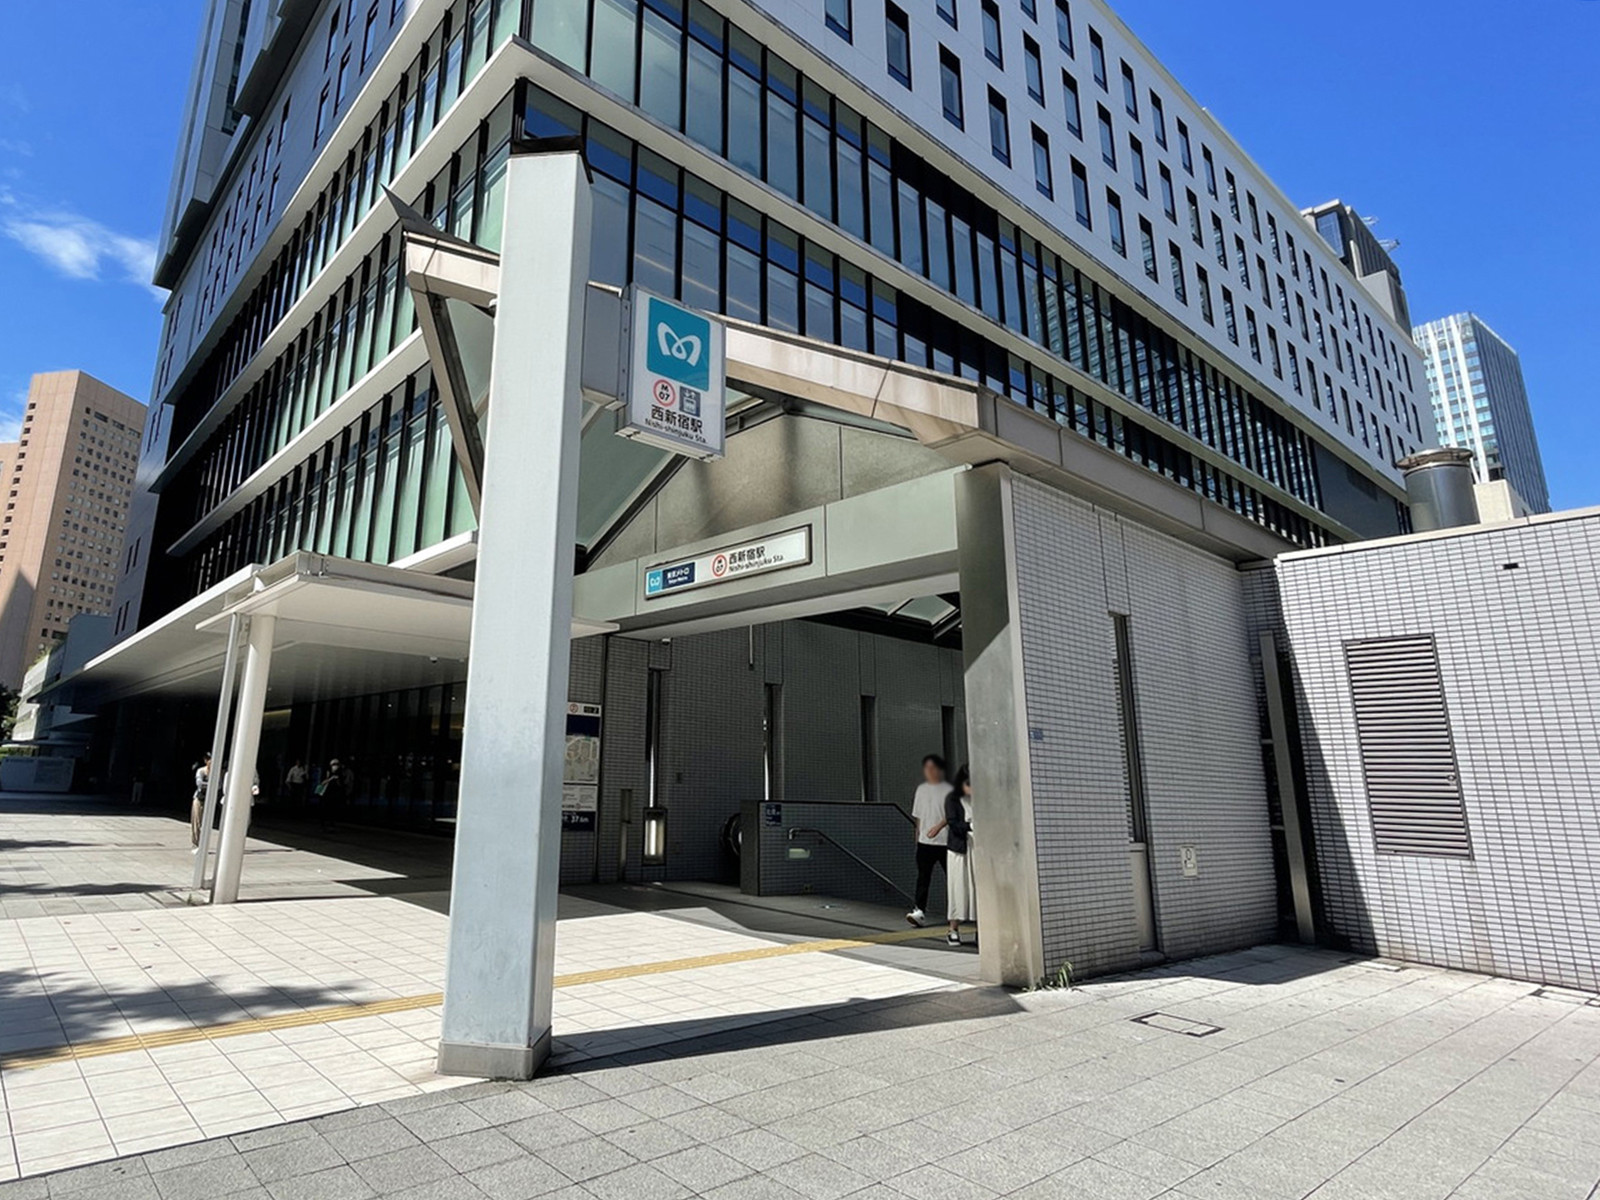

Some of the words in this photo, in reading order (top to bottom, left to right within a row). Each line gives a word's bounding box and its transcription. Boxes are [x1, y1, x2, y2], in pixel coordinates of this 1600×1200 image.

[658, 391, 670, 401] 07
[651, 404, 703, 434] 西新宿駅
[729, 546, 765, 565] 西新宿駅
